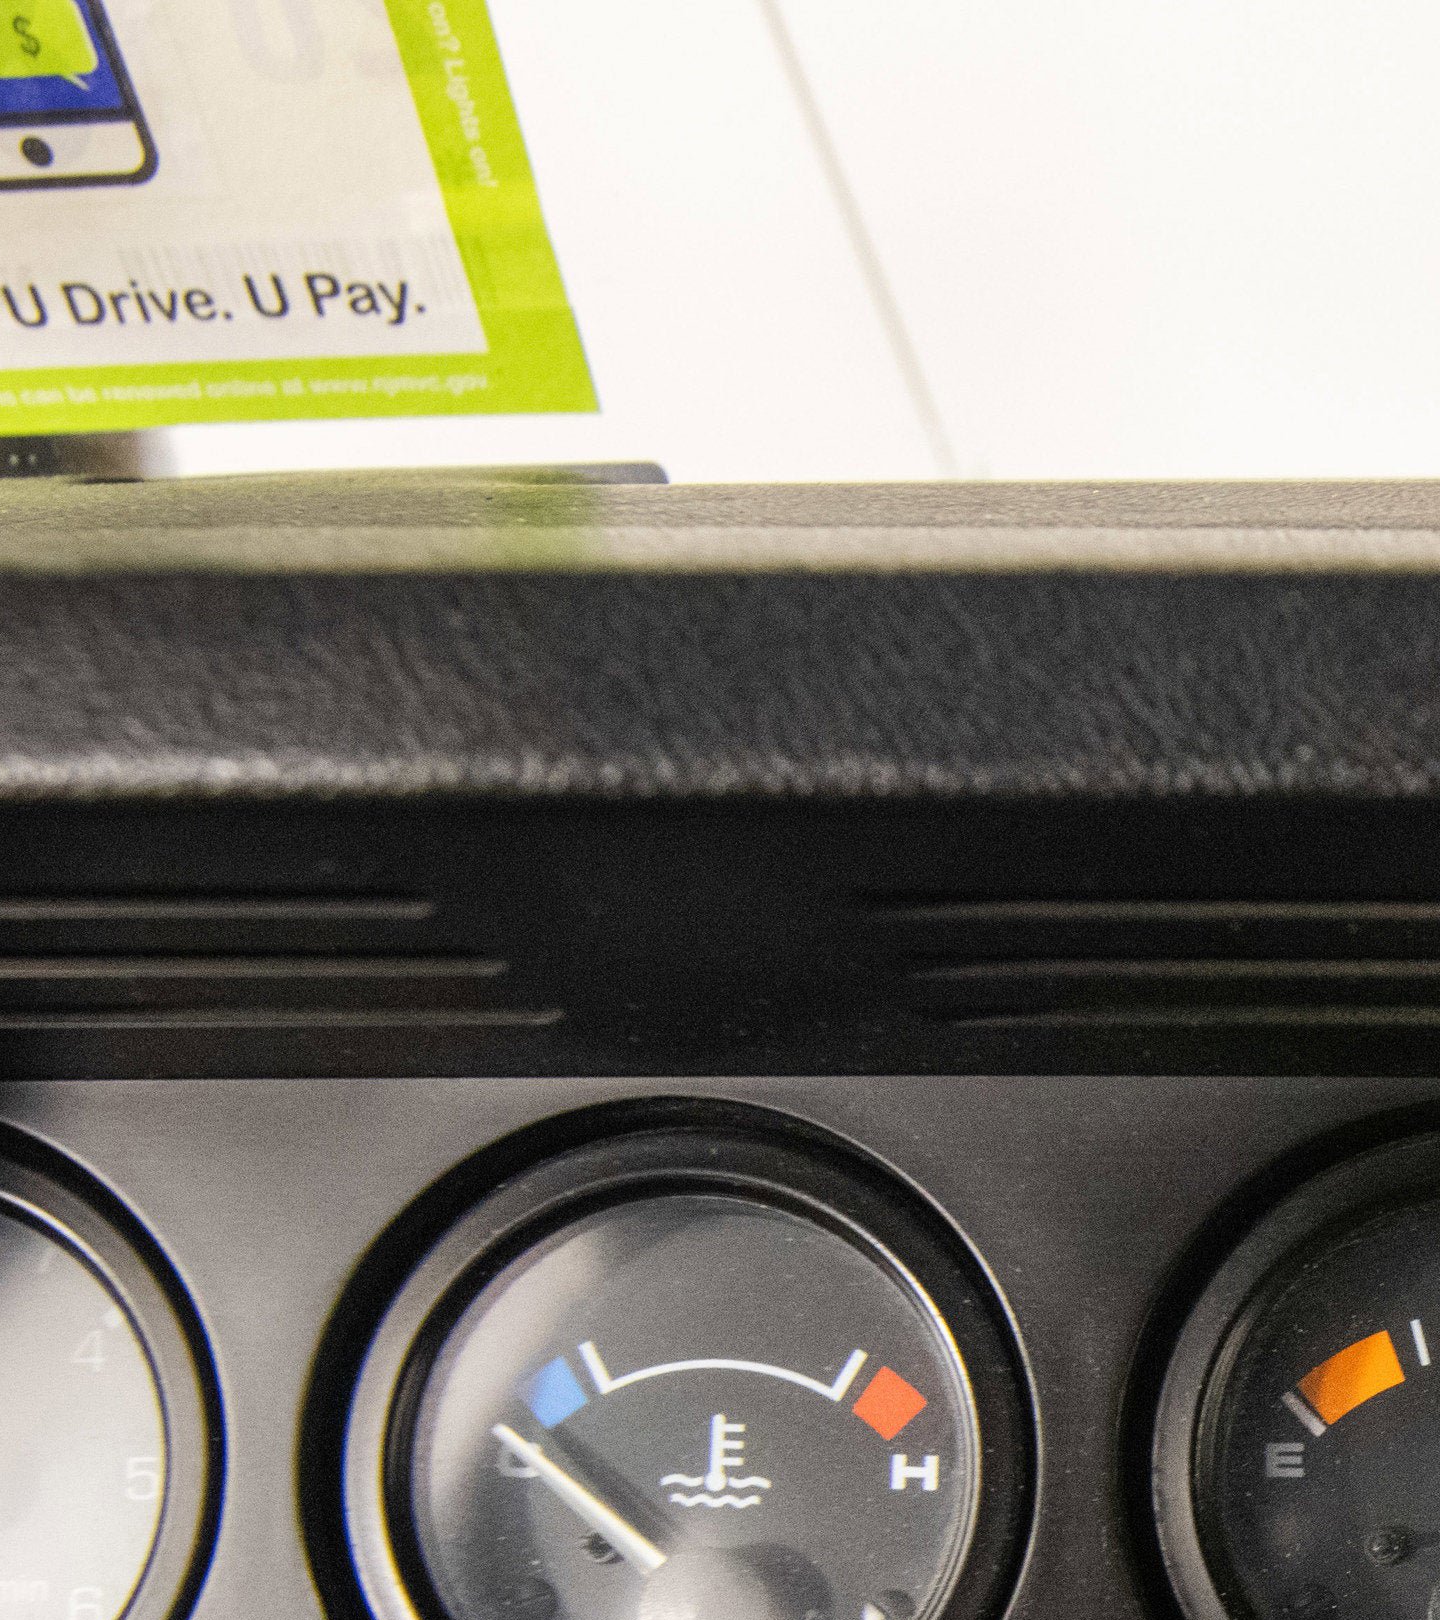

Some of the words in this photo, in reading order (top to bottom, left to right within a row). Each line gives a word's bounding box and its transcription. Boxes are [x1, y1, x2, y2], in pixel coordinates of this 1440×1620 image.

[0, 283, 50, 327] U
[62, 278, 235, 325] Drive.
[245, 274, 291, 319] U
[305, 274, 427, 325] Pay.
[71, 1330, 106, 1373] 4
[125, 1456, 160, 1500] 5
[891, 1453, 940, 1492] H
[1265, 1442, 1304, 1479] E
